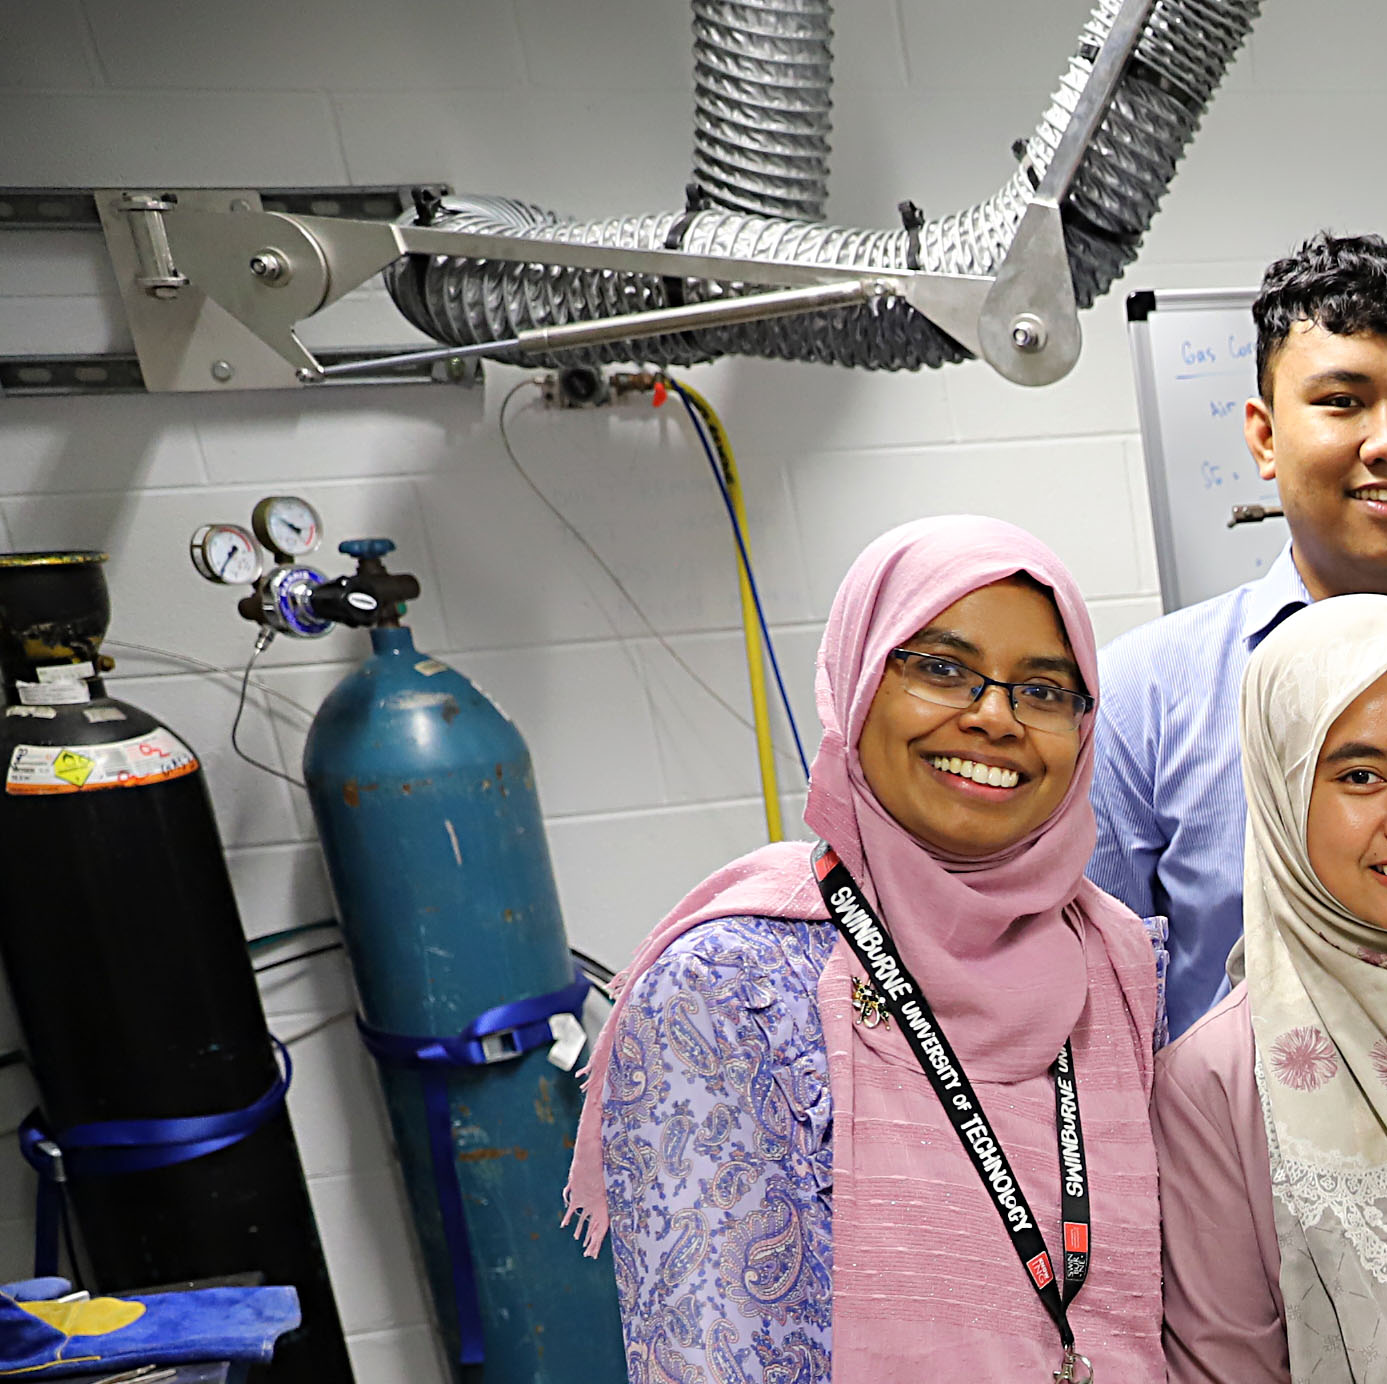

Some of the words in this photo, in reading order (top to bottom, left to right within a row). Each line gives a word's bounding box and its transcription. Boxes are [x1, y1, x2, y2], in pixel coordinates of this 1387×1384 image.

[1181, 340, 1216, 365] Gas
[830, 885, 914, 1001] SWINBURNE
[901, 1000, 962, 1091] UNIVERSITY
[952, 1093, 973, 1112] OF
[1056, 1076, 1084, 1198] SWINBURNE
[960, 1112, 1033, 1233] TECHNOLOGY
